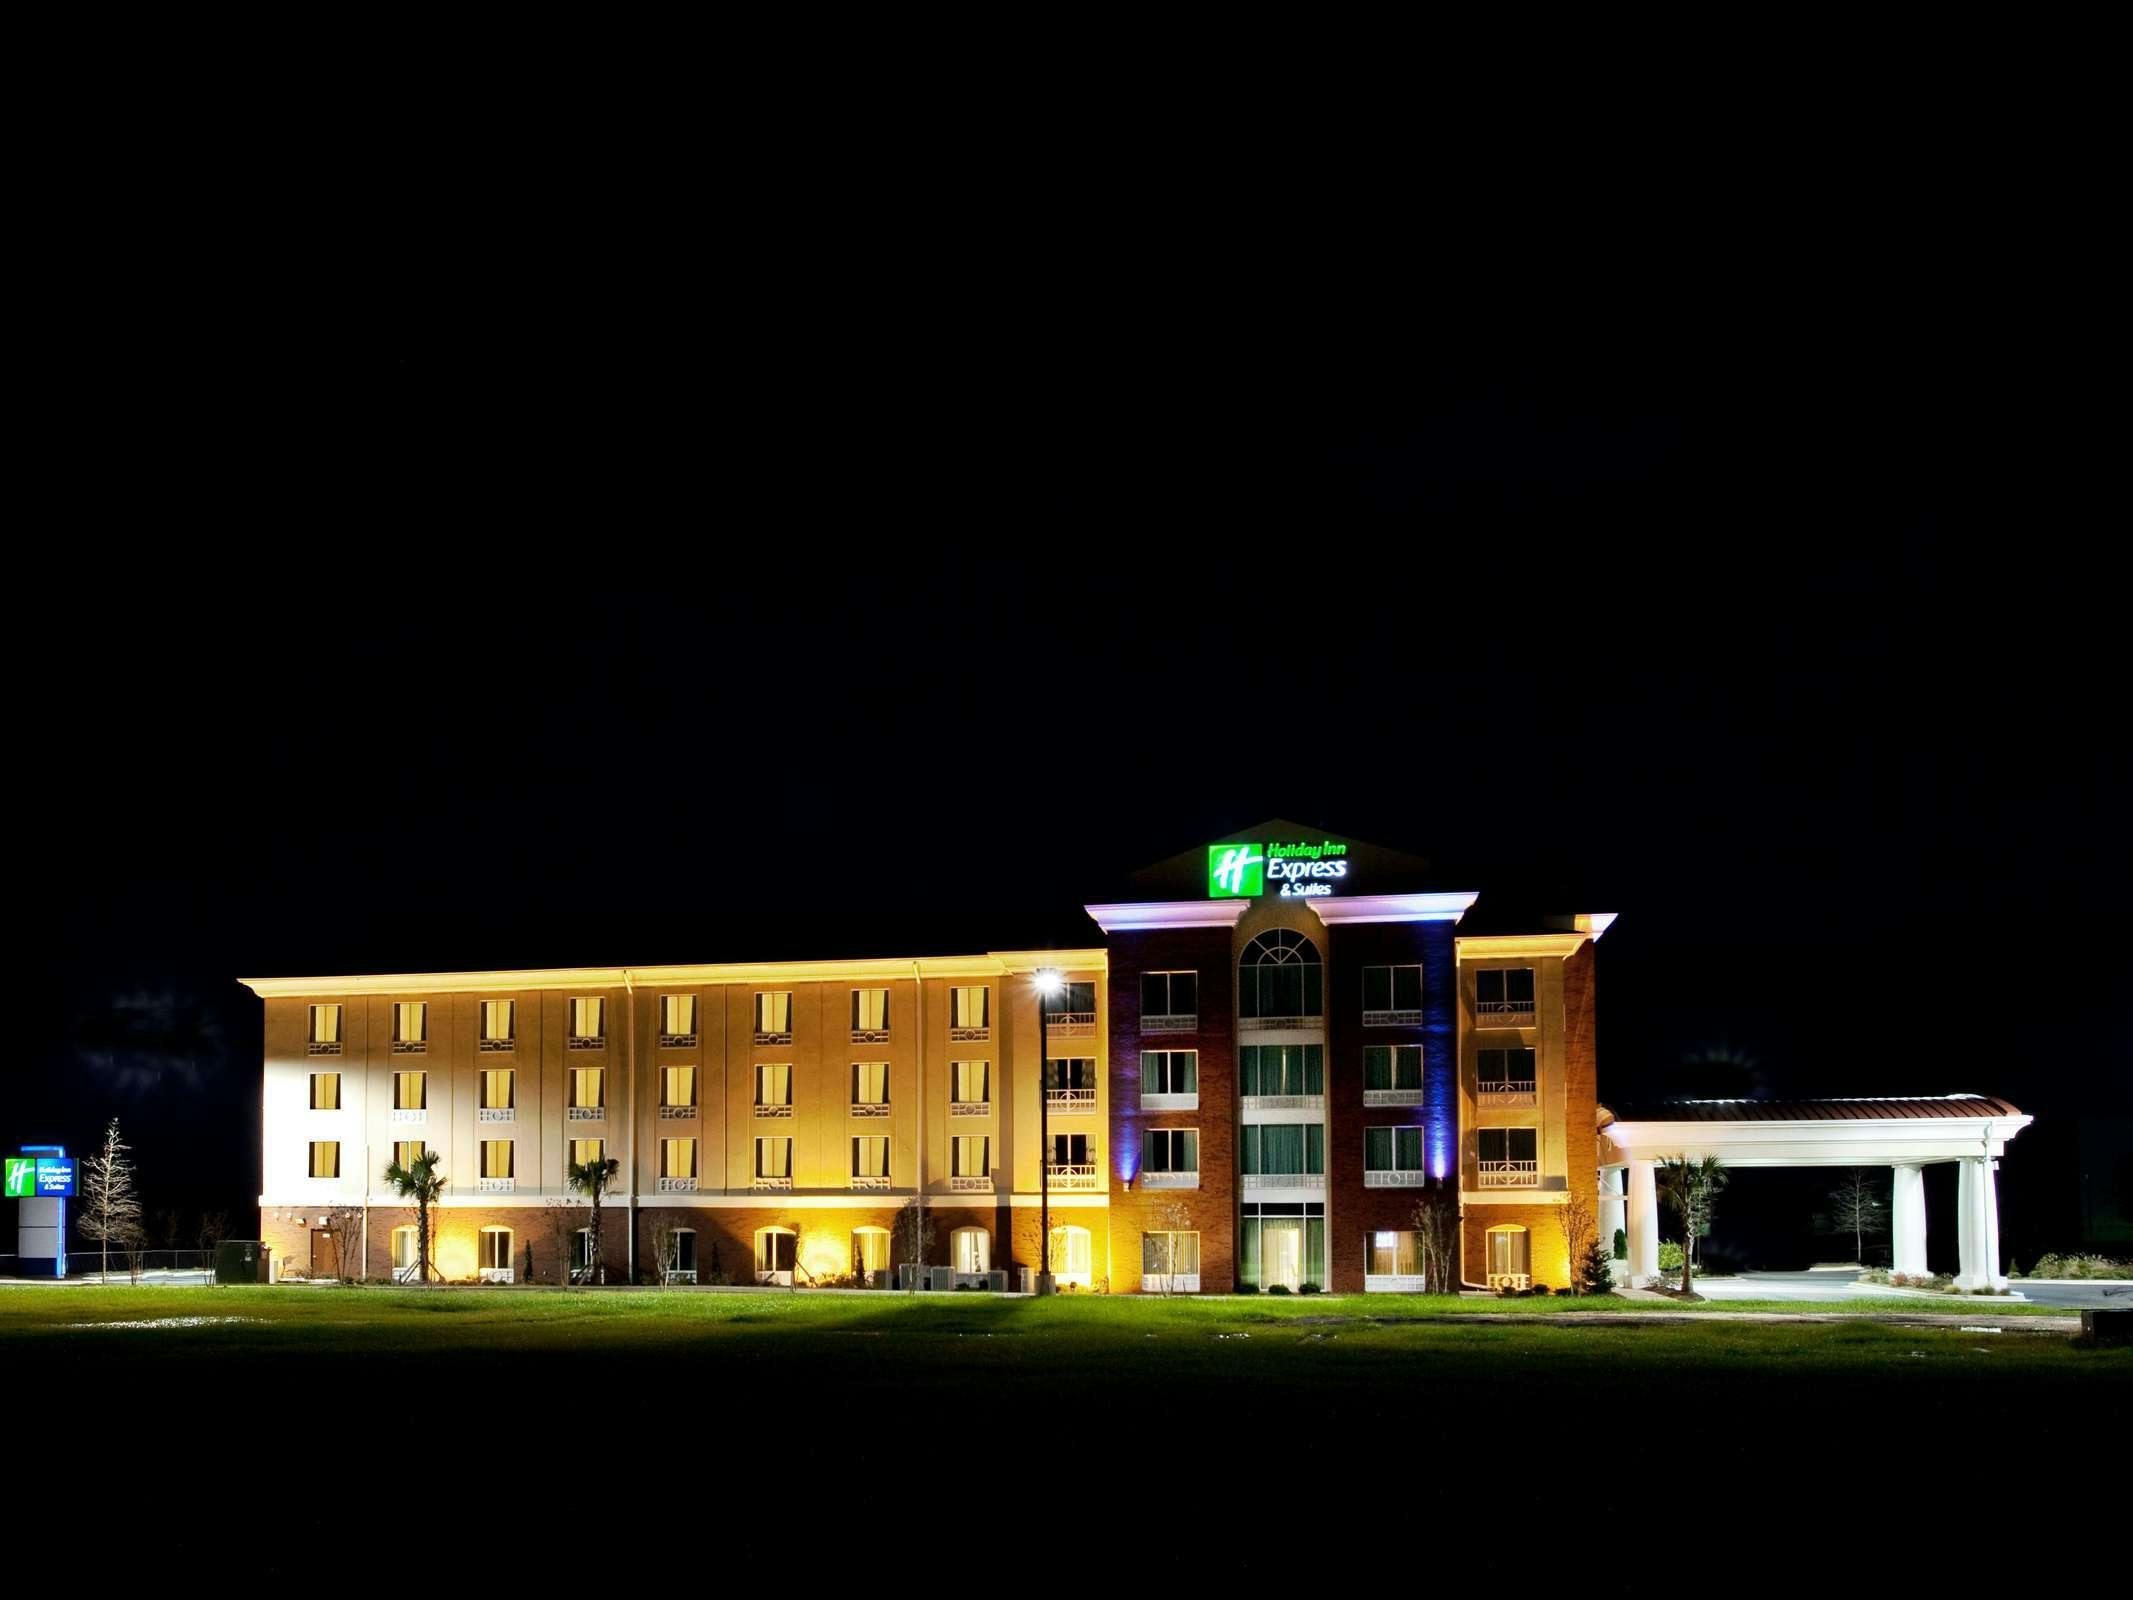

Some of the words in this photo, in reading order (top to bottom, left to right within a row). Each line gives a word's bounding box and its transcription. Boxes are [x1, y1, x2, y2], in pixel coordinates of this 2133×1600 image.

[1267, 842, 1322, 859] Holiday
[1322, 841, 1346, 856] Inn
[1267, 858, 1347, 882] Express
[1280, 883, 1291, 896] &
[1292, 883, 1331, 896] Suites
[39, 1174, 72, 1185] Express
